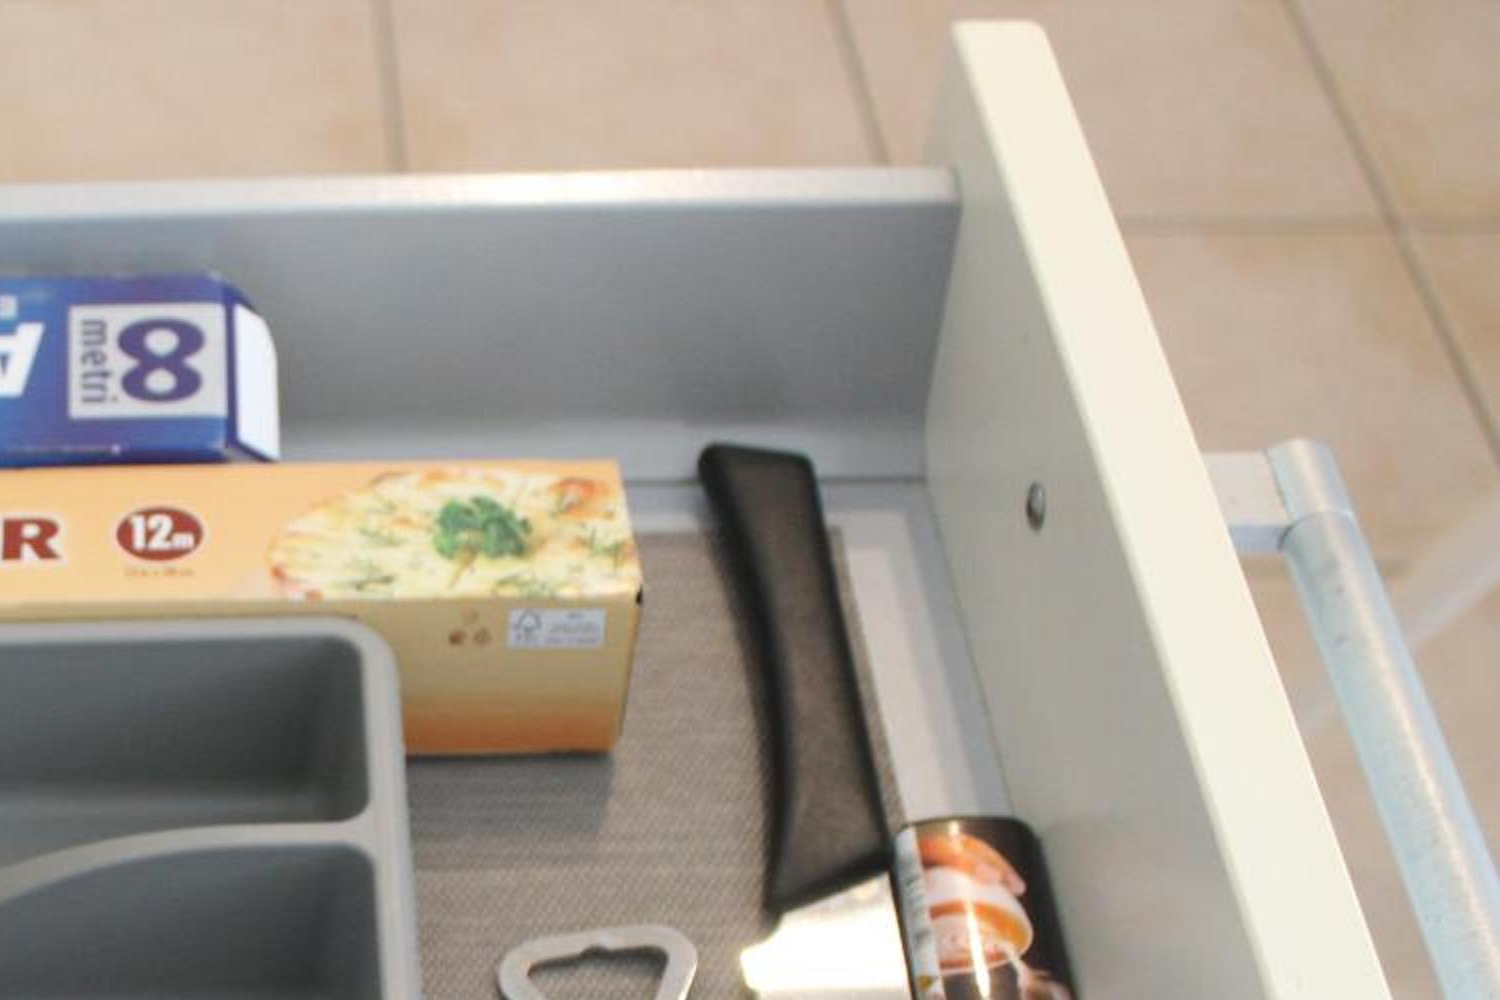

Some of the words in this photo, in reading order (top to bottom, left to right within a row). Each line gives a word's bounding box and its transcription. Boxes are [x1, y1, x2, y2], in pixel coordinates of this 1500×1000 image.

[81, 319, 118, 404] metri
[116, 317, 206, 404] 8
[132, 513, 195, 551] 12m
